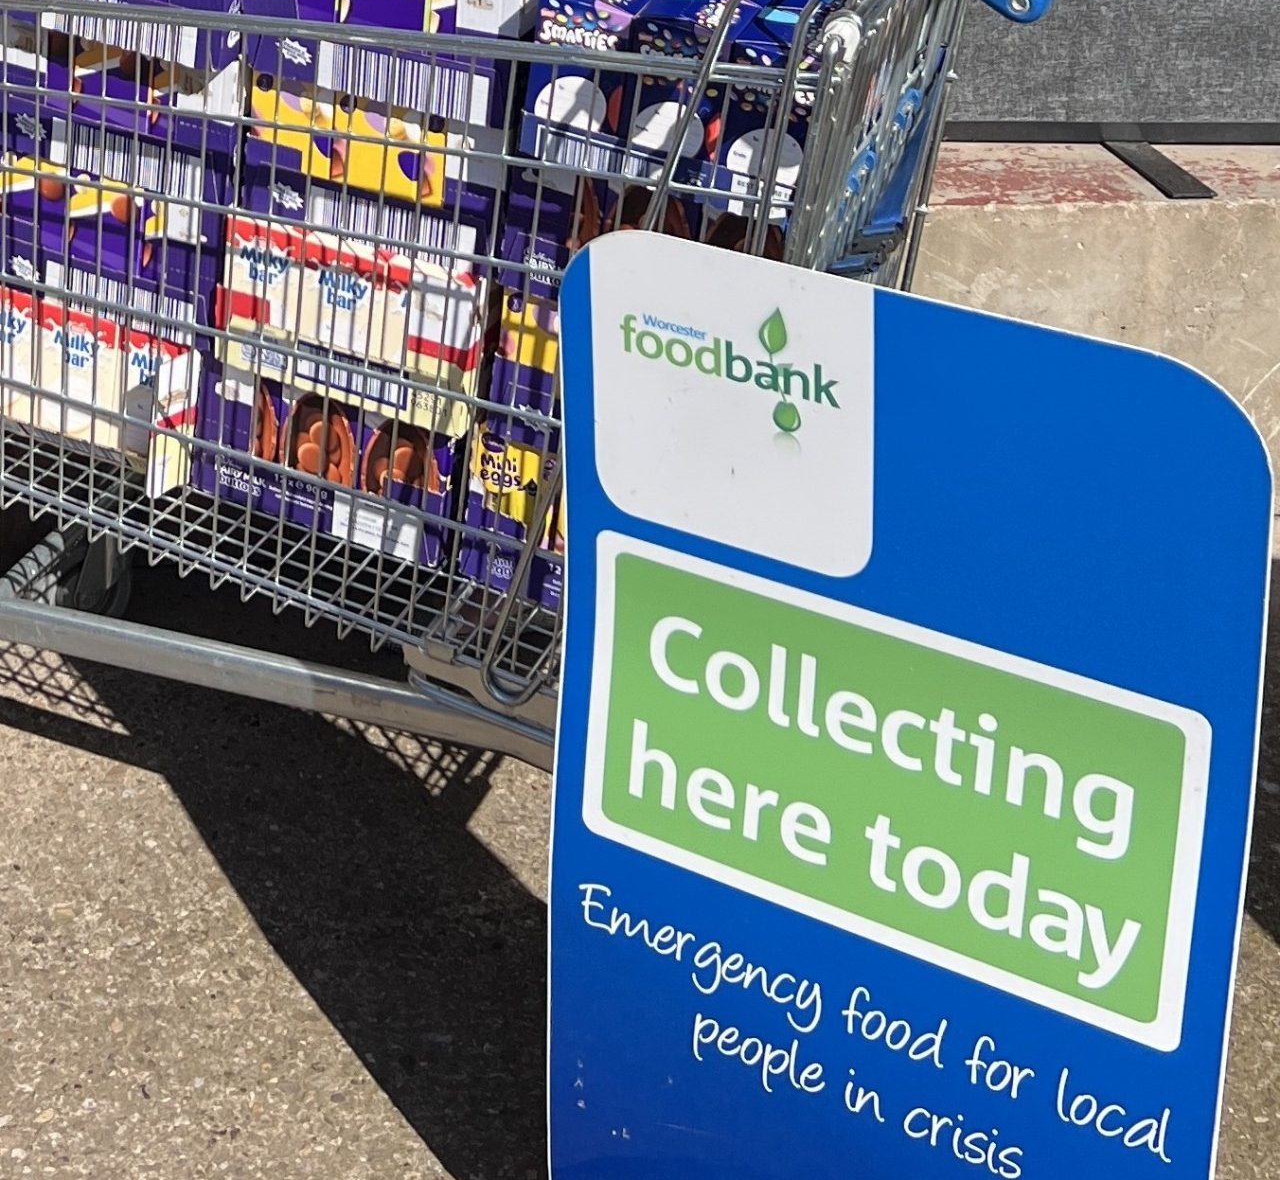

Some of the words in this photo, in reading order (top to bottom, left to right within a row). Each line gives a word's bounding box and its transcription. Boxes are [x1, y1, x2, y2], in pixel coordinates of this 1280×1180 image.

[620, 315, 840, 409] foodbank
[642, 314, 706, 340] Worcester
[480, 468, 521, 488] eggs
[481, 452, 517, 472] Mini
[650, 616, 1135, 859] Collecting
[628, 720, 832, 866] here
[866, 814, 1142, 990] today
[578, 882, 822, 1033] Emergency
[841, 987, 944, 1070] food
[965, 1037, 1035, 1100] for
[1055, 1067, 1172, 1164] local
[692, 1012, 825, 1093] people
[844, 1070, 885, 1123] in
[903, 1105, 1023, 1179] crisis
